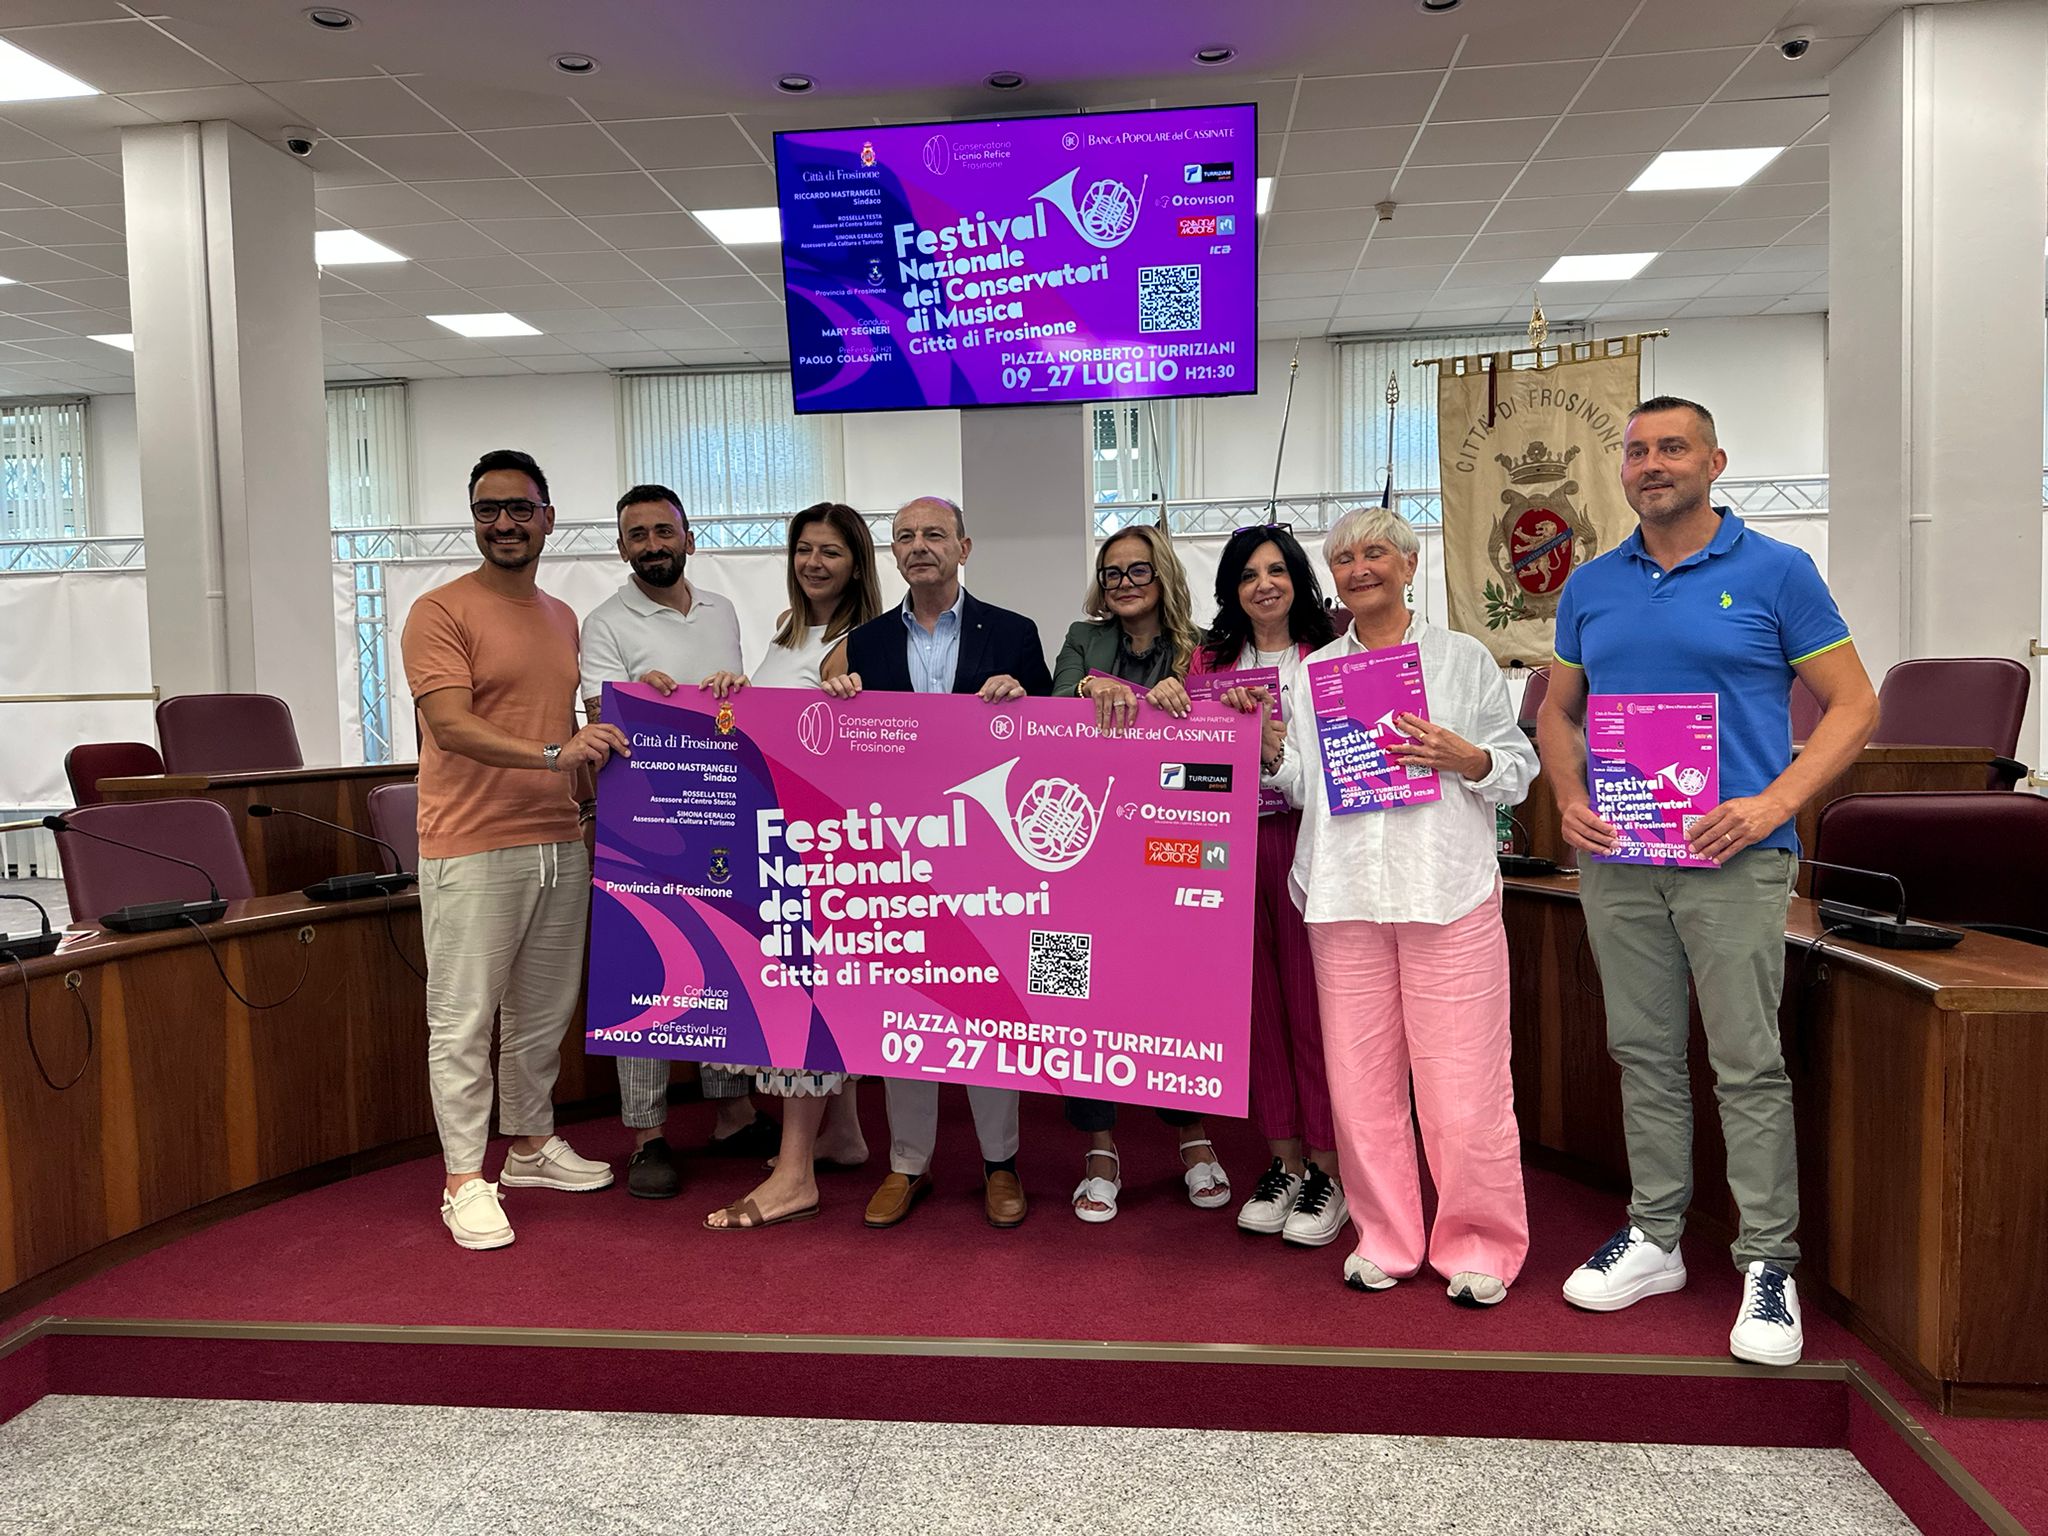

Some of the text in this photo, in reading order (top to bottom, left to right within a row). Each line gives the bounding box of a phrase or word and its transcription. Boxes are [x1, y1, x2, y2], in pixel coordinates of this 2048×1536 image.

[1088, 128, 1234, 146] BANCA POPOLARE del CASSINATE
[953, 142, 1012, 151] Conservatorio
[954, 150, 1011, 161] Licinio Refice
[963, 162, 1003, 170] Frosinone
[803, 169, 880, 182] Città di Frosinone
[794, 189, 881, 200] RICCARDO MASTRANGELI
[853, 198, 881, 206] Sindaco
[1172, 195, 1234, 207] Otovision
[894, 202, 1047, 258] Festival
[899, 244, 1024, 284] Nazionale
[903, 256, 1109, 309] dei Conservatori
[906, 298, 1023, 333] di Musica
[822, 326, 890, 337] MARY SEGNERI
[909, 320, 1077, 355] Città di Frosinone
[800, 353, 892, 364] PAOLO COLASANTI
[1002, 341, 1235, 365] PIAZZA NORBERTO TURRIZIANI
[1002, 360, 1235, 392] 09_27 LUGLIO H21:30
[1498, 397, 1517, 419] DI
[1529, 388, 1623, 454] FROSINONE
[838, 714, 919, 729] Conservatorio
[839, 727, 918, 741] Licinio Refice
[1027, 721, 1073, 738] BANCA
[1145, 729, 1161, 740] del
[1164, 726, 1236, 743] CASSINATE
[1324, 724, 1384, 751] Festival
[633, 733, 739, 751] Città di Frosinone
[850, 740, 906, 754] Frosinone
[1327, 741, 1376, 760] Nazionale
[631, 760, 737, 774] RICCARDO MASTRANGELI
[1329, 757, 1344, 769] dei
[1331, 760, 1378, 778] di Musica
[704, 773, 737, 783] Sindaco
[1189, 775, 1228, 783] TURRIZIANI
[1333, 765, 1400, 785] Città di Frosinone
[1340, 786, 1362, 794] PIAZZA
[1595, 775, 1664, 793] Festival
[650, 796, 682, 804] Assessore
[691, 797, 712, 805] Centro
[713, 798, 736, 806] Storico
[683, 790, 736, 799] ROSSELLA TESTA
[1342, 796, 1371, 808] 09_27
[1373, 790, 1412, 803] LUGLIO
[1597, 791, 1653, 802] Nazionale
[1598, 798, 1692, 812] dei Conservatori
[666, 816, 678, 824] alla
[679, 817, 703, 825] Cultura
[709, 819, 735, 827] Turismo
[677, 810, 736, 820] SIMONA GERALICO
[1140, 804, 1230, 824] Otovision
[1612, 811, 1653, 822] Musica
[756, 800, 967, 853] Festival
[1624, 822, 1633, 830] di
[1634, 822, 1677, 830] Frosinone
[1644, 848, 1687, 859] LUGLIO
[1646, 842, 1686, 850] TURRIZIANI
[759, 851, 933, 888] Nazionale
[606, 881, 733, 898] Provincia di Frosinone
[759, 881, 1050, 922] dei Conservatori
[760, 921, 925, 957] di Musica
[760, 960, 999, 987] Città di Frosinone
[684, 985, 729, 998] Conduce
[632, 994, 728, 1011] MARY SEGNERI
[653, 1021, 727, 1036] PreFestival H21
[594, 1029, 726, 1049] PAOLO COLASANTI
[883, 1011, 1223, 1063] PIAZZA NORBERTO TURRIZIANI
[881, 1032, 1223, 1098] 09_27 LUGLIO H21:30
